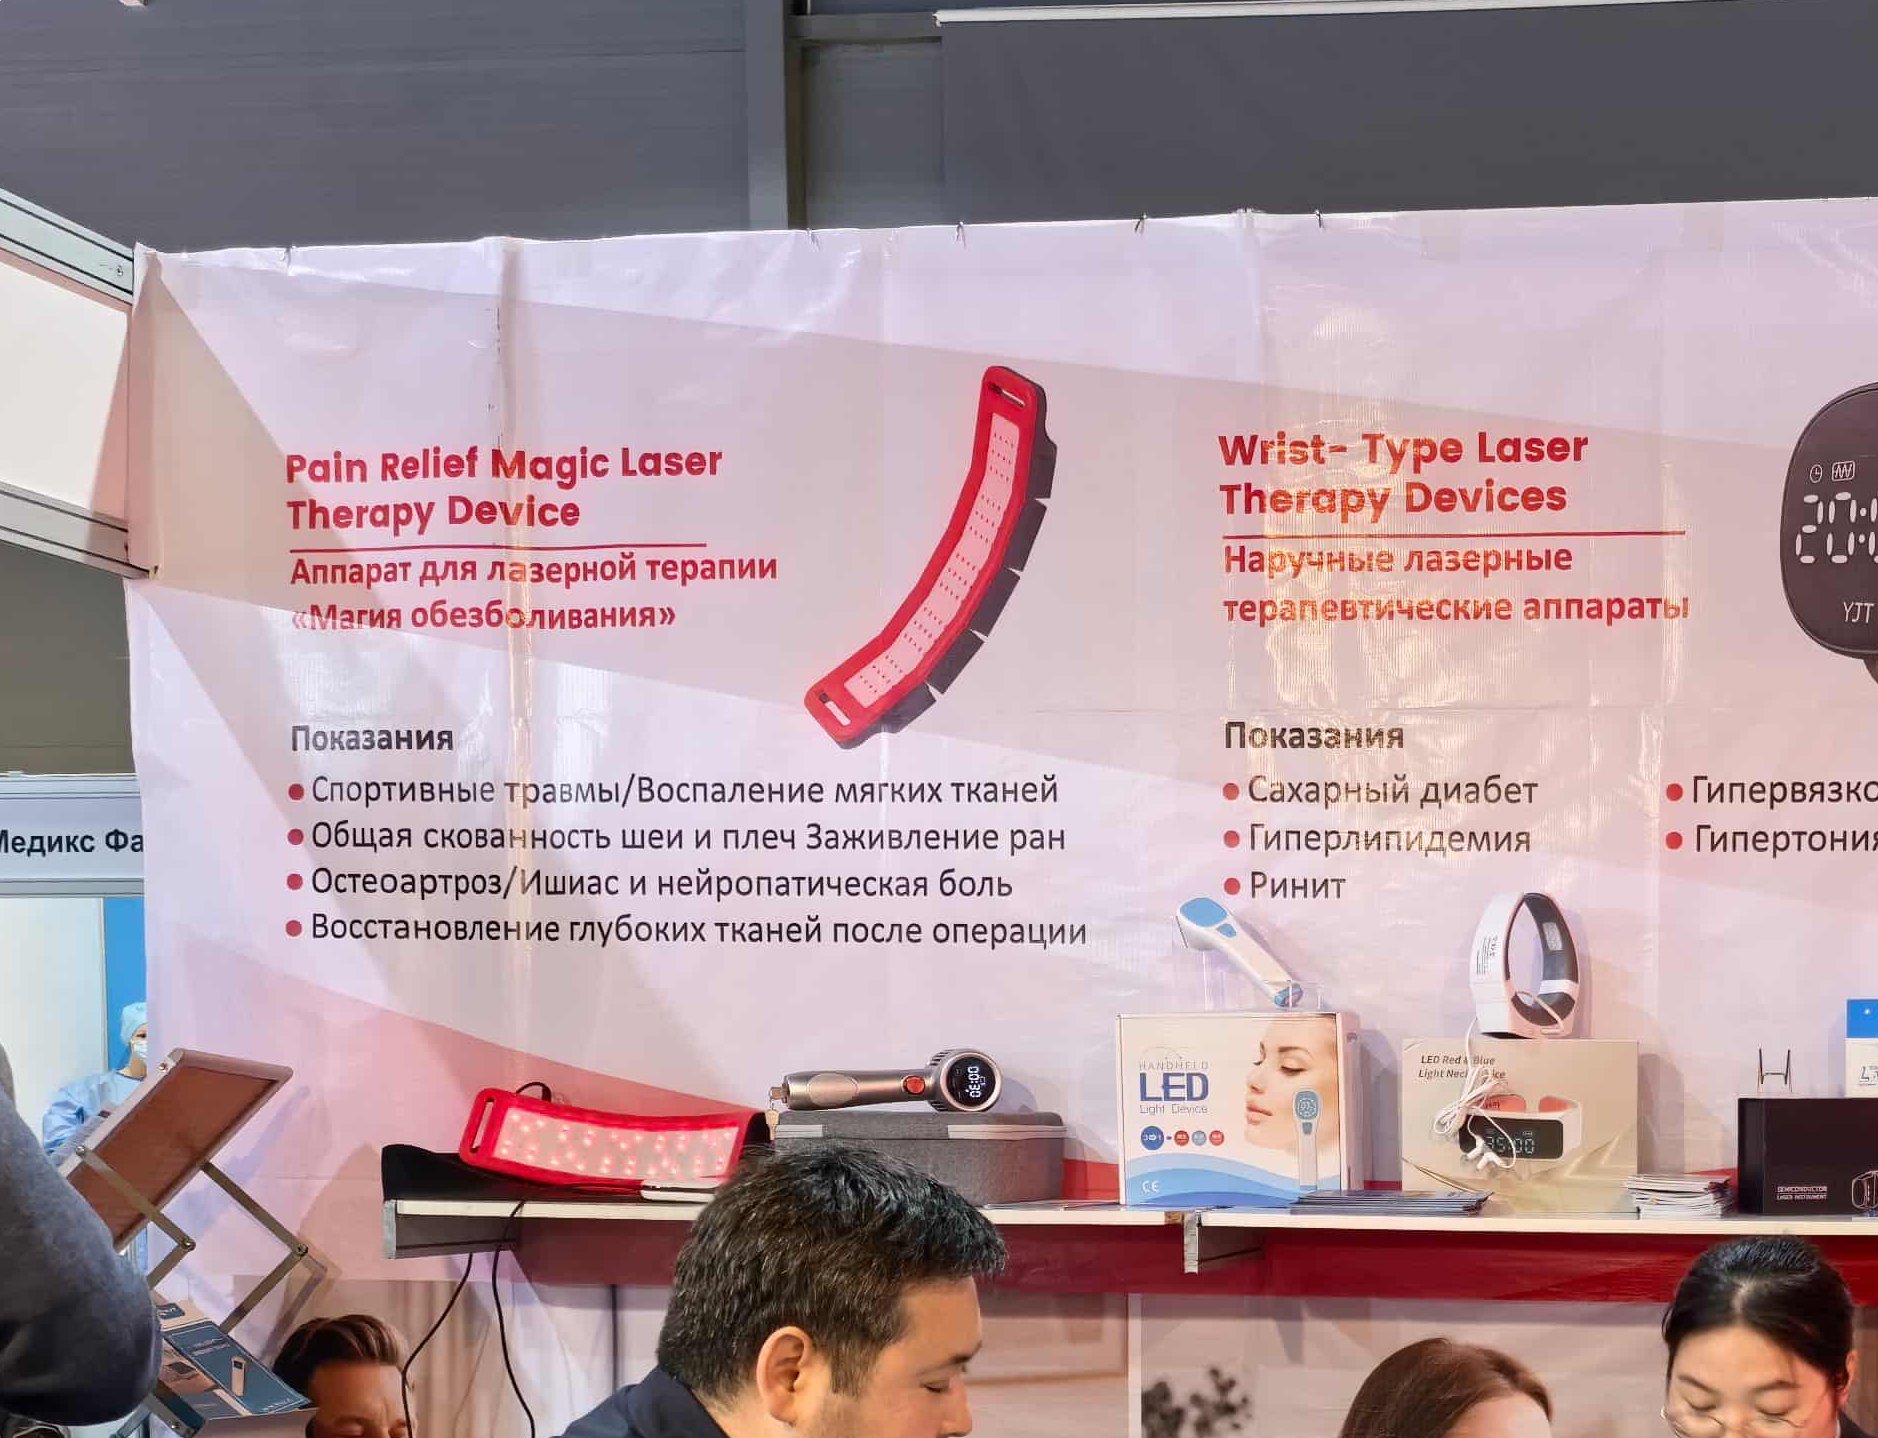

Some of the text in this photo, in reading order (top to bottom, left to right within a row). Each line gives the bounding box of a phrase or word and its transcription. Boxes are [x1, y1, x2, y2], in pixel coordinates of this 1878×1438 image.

[285, 446, 723, 489] Pain Relief Magic Laser
[1218, 430, 1590, 477] Wrist- Type Laser
[286, 494, 581, 537] Therapy Device
[1218, 479, 1568, 525] Therapy Devices
[290, 550, 778, 590] Аппарат для лазерной терапии
[1224, 543, 1574, 580] Наручные лазерные
[292, 600, 677, 633] «Магия обезболивания»
[1223, 594, 1692, 628] терапевтические аппараты
[1842, 600, 1874, 623] YJT
[291, 725, 455, 754] Показания
[1223, 721, 1405, 751] Показания
[312, 773, 1058, 809] Спортивные травмы/Воспаление мягких тканей
[1248, 774, 1539, 812] Сахарный диабет
[105, 828, 144, 853] Фа
[312, 821, 1066, 857] Общая скованность шеи и плеч Заживление ран
[1248, 824, 1533, 860] Гиперлипидемия
[312, 864, 1014, 902] Остеоартроз/Ишиас и нейропатическая боль
[1248, 871, 1348, 903] Ринит
[311, 911, 1088, 952] Восстановление глубоких тканей после операции
[1139, 1061, 1209, 1070] HANDHELD
[1418, 1069, 1444, 1080] Light
[1421, 1055, 1440, 1065] LED
[1442, 1055, 1461, 1065] Red
[1472, 1055, 1496, 1066] Blue
[1139, 1072, 1209, 1102] LED
[1139, 1103, 1208, 1116] Light Device
[1142, 1180, 1160, 1192] CE
